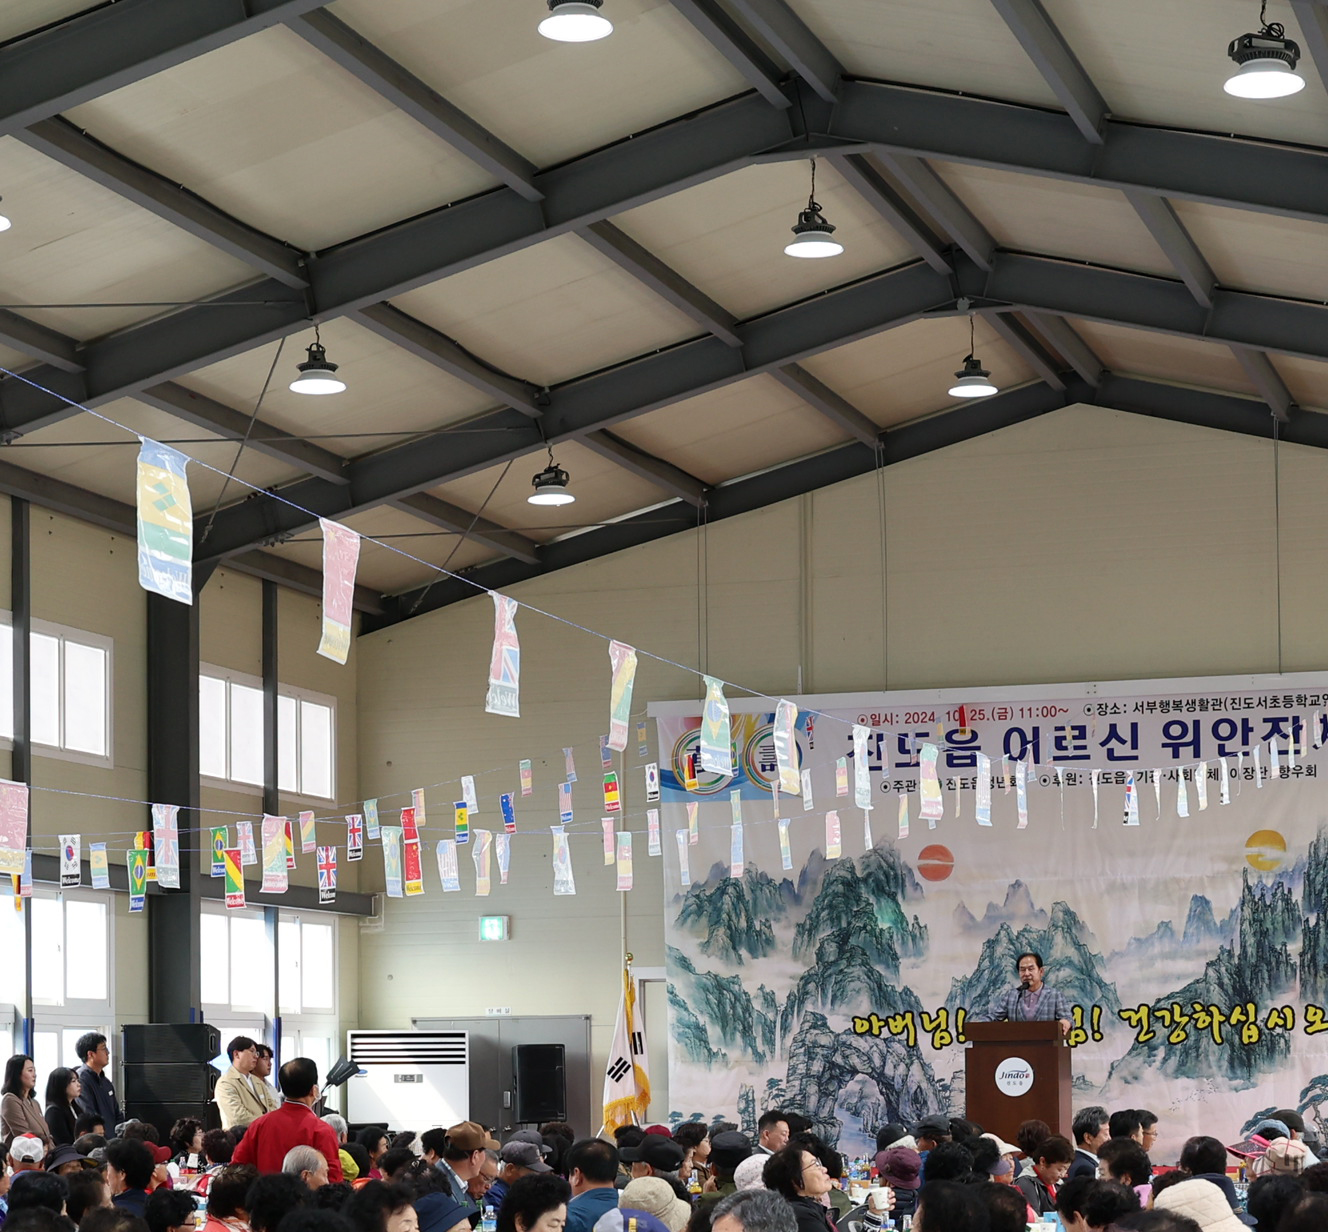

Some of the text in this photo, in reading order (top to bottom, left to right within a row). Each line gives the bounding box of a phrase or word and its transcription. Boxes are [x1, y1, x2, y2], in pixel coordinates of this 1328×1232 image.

[1096, 701, 1127, 717] 장소:
[870, 711, 899, 727] 일시:
[1003, 721, 1140, 766] 어르신
[852, 1006, 967, 1050] 아버님!
[998, 1071, 1025, 1080] Jindo
